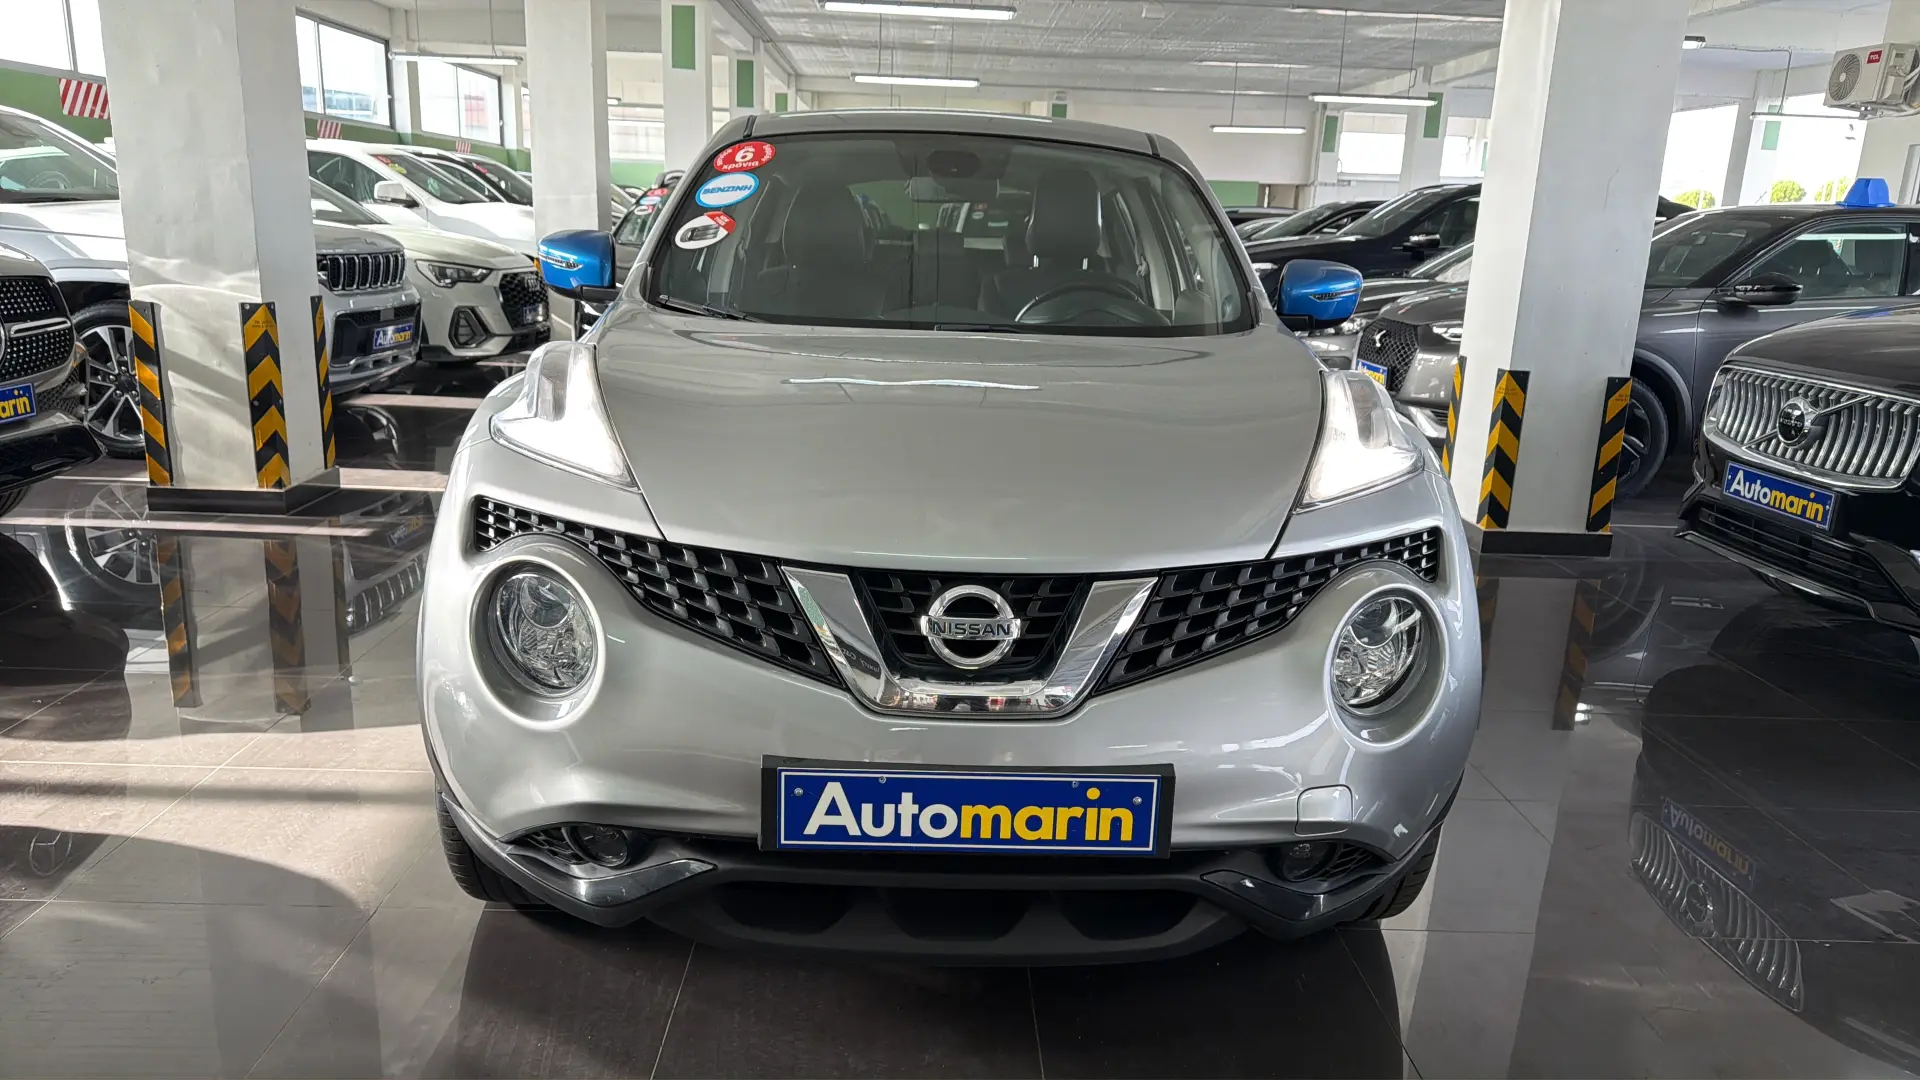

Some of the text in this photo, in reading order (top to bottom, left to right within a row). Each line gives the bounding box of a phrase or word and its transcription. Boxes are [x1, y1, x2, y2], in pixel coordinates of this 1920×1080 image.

[735, 147, 755, 162] 6
[1730, 470, 1824, 521] Automarin
[932, 621, 1011, 636] NISSAN
[803, 781, 1134, 841] Automarin
